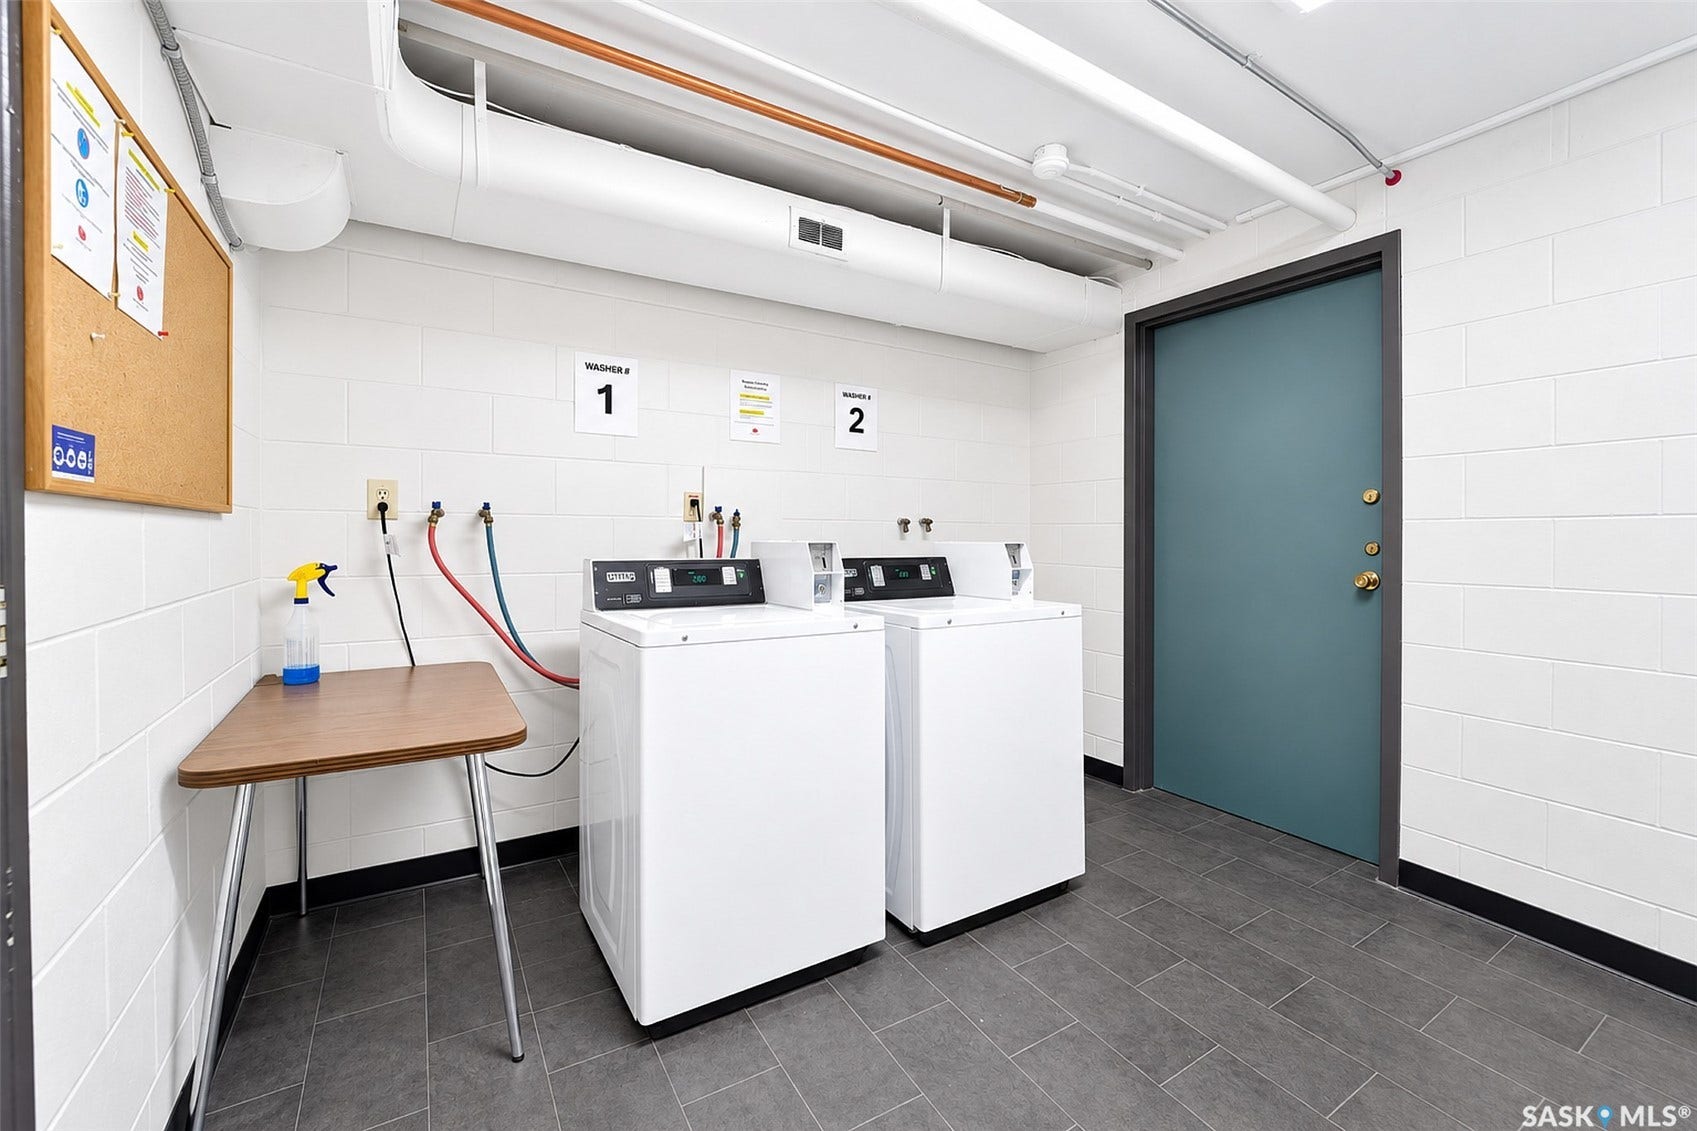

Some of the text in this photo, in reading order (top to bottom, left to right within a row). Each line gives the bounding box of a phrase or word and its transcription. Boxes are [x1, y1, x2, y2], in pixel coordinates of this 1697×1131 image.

[585, 362, 623, 375] WASHER
[597, 384, 612, 415] 1
[849, 407, 865, 434] 2
